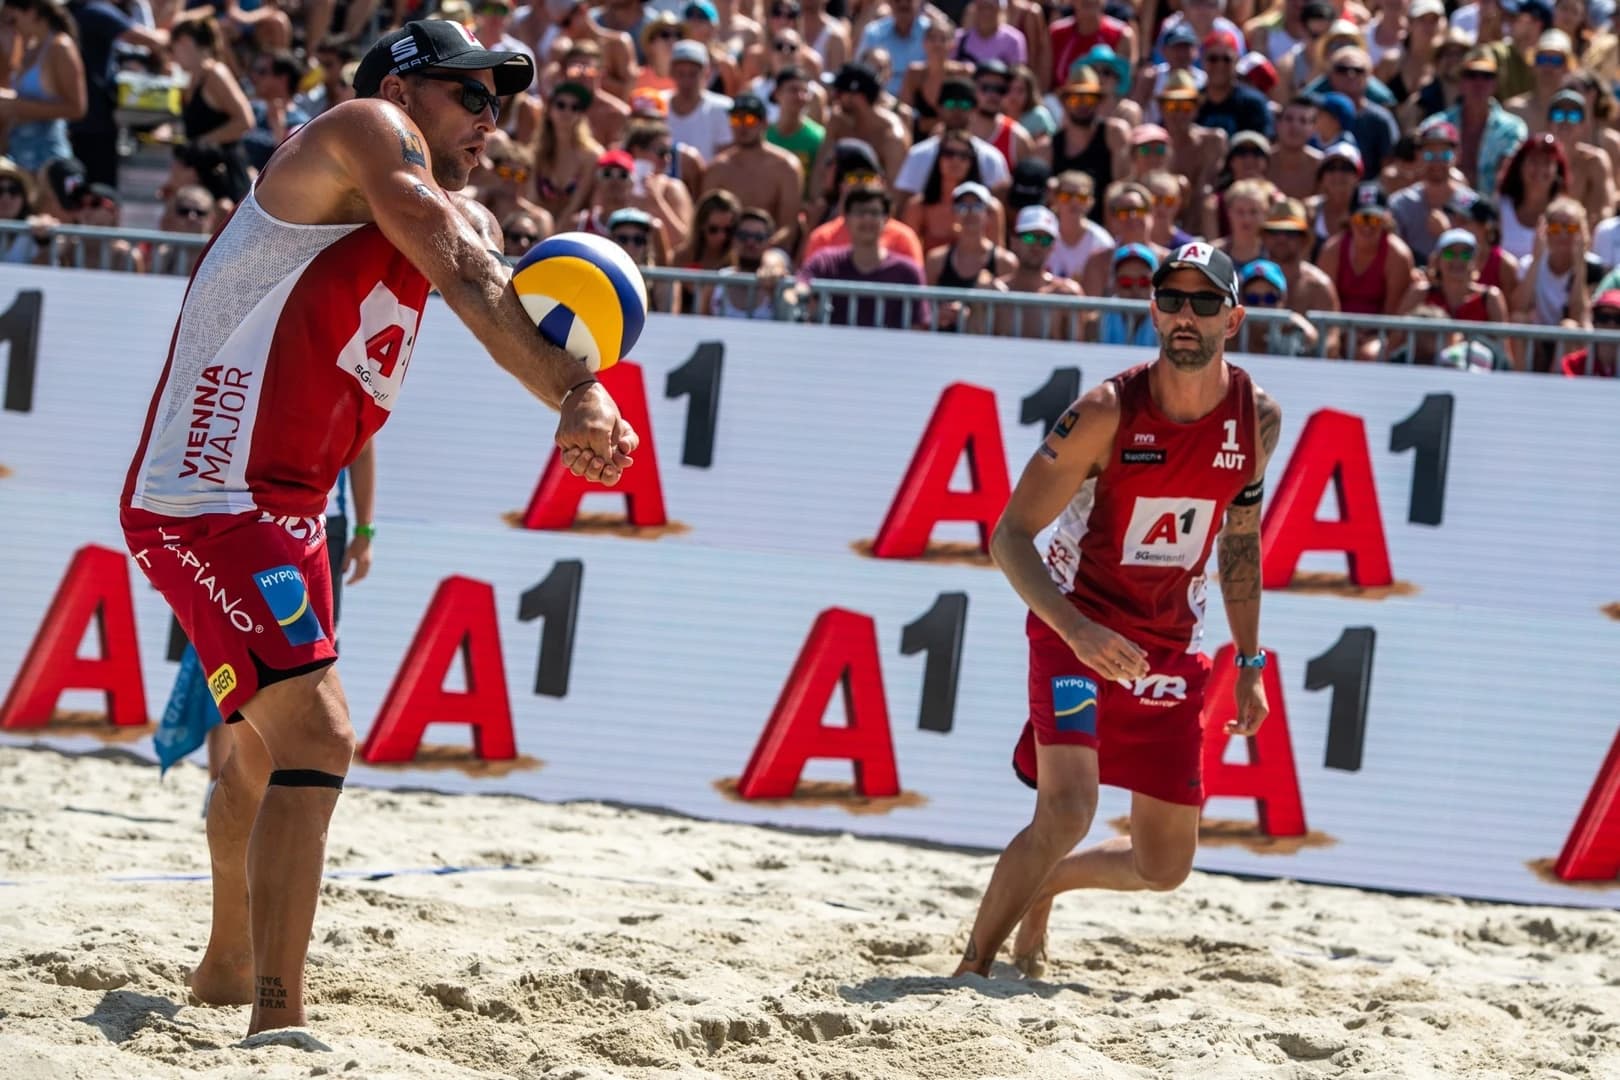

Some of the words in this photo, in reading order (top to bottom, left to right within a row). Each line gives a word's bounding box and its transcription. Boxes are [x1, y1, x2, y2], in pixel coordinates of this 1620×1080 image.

[388, 54, 431, 75] SEAT
[178, 365, 224, 478] VIENNA
[198, 367, 253, 484] MAJOR
[522, 340, 725, 531] A1
[872, 365, 1081, 559] A1
[1212, 451, 1246, 471] AUT
[1221, 419, 1240, 451] 1
[1140, 507, 1197, 545] A1
[1261, 391, 1455, 590] A1
[260, 569, 294, 588] HYPO
[360, 557, 584, 765] A1
[736, 589, 969, 801] A1
[1055, 679, 1084, 689] HYPO
[1199, 625, 1377, 836] A1
